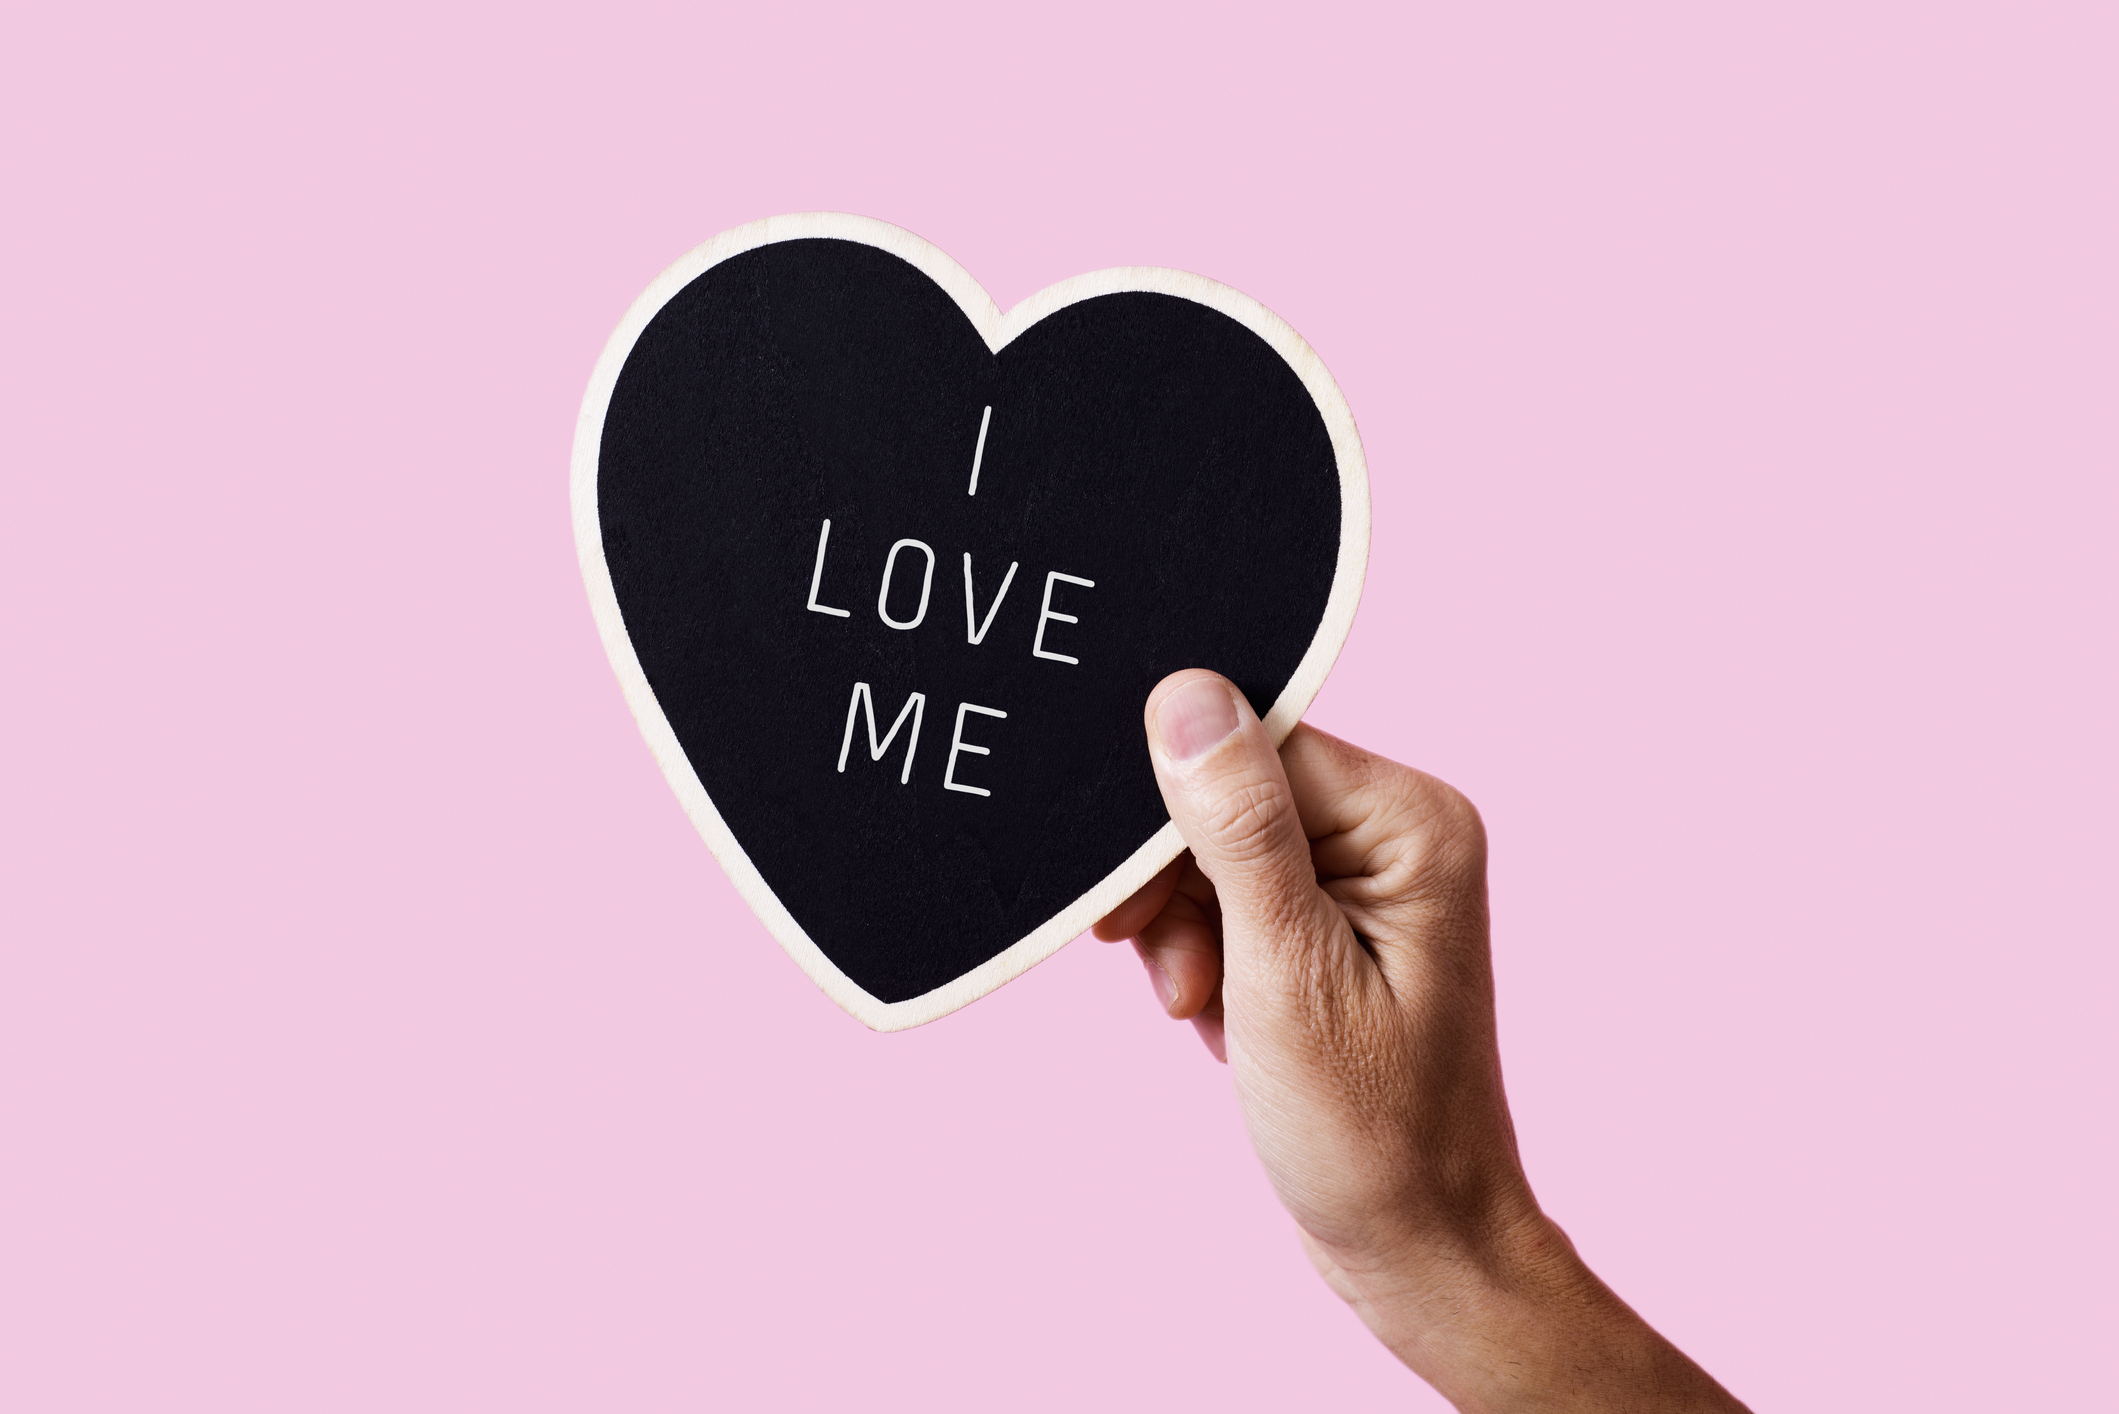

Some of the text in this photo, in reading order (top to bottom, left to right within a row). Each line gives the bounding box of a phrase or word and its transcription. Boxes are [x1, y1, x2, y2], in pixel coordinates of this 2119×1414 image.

[967, 405, 992, 497] I
[806, 518, 1096, 665] LOVE
[837, 681, 1008, 797] ME
